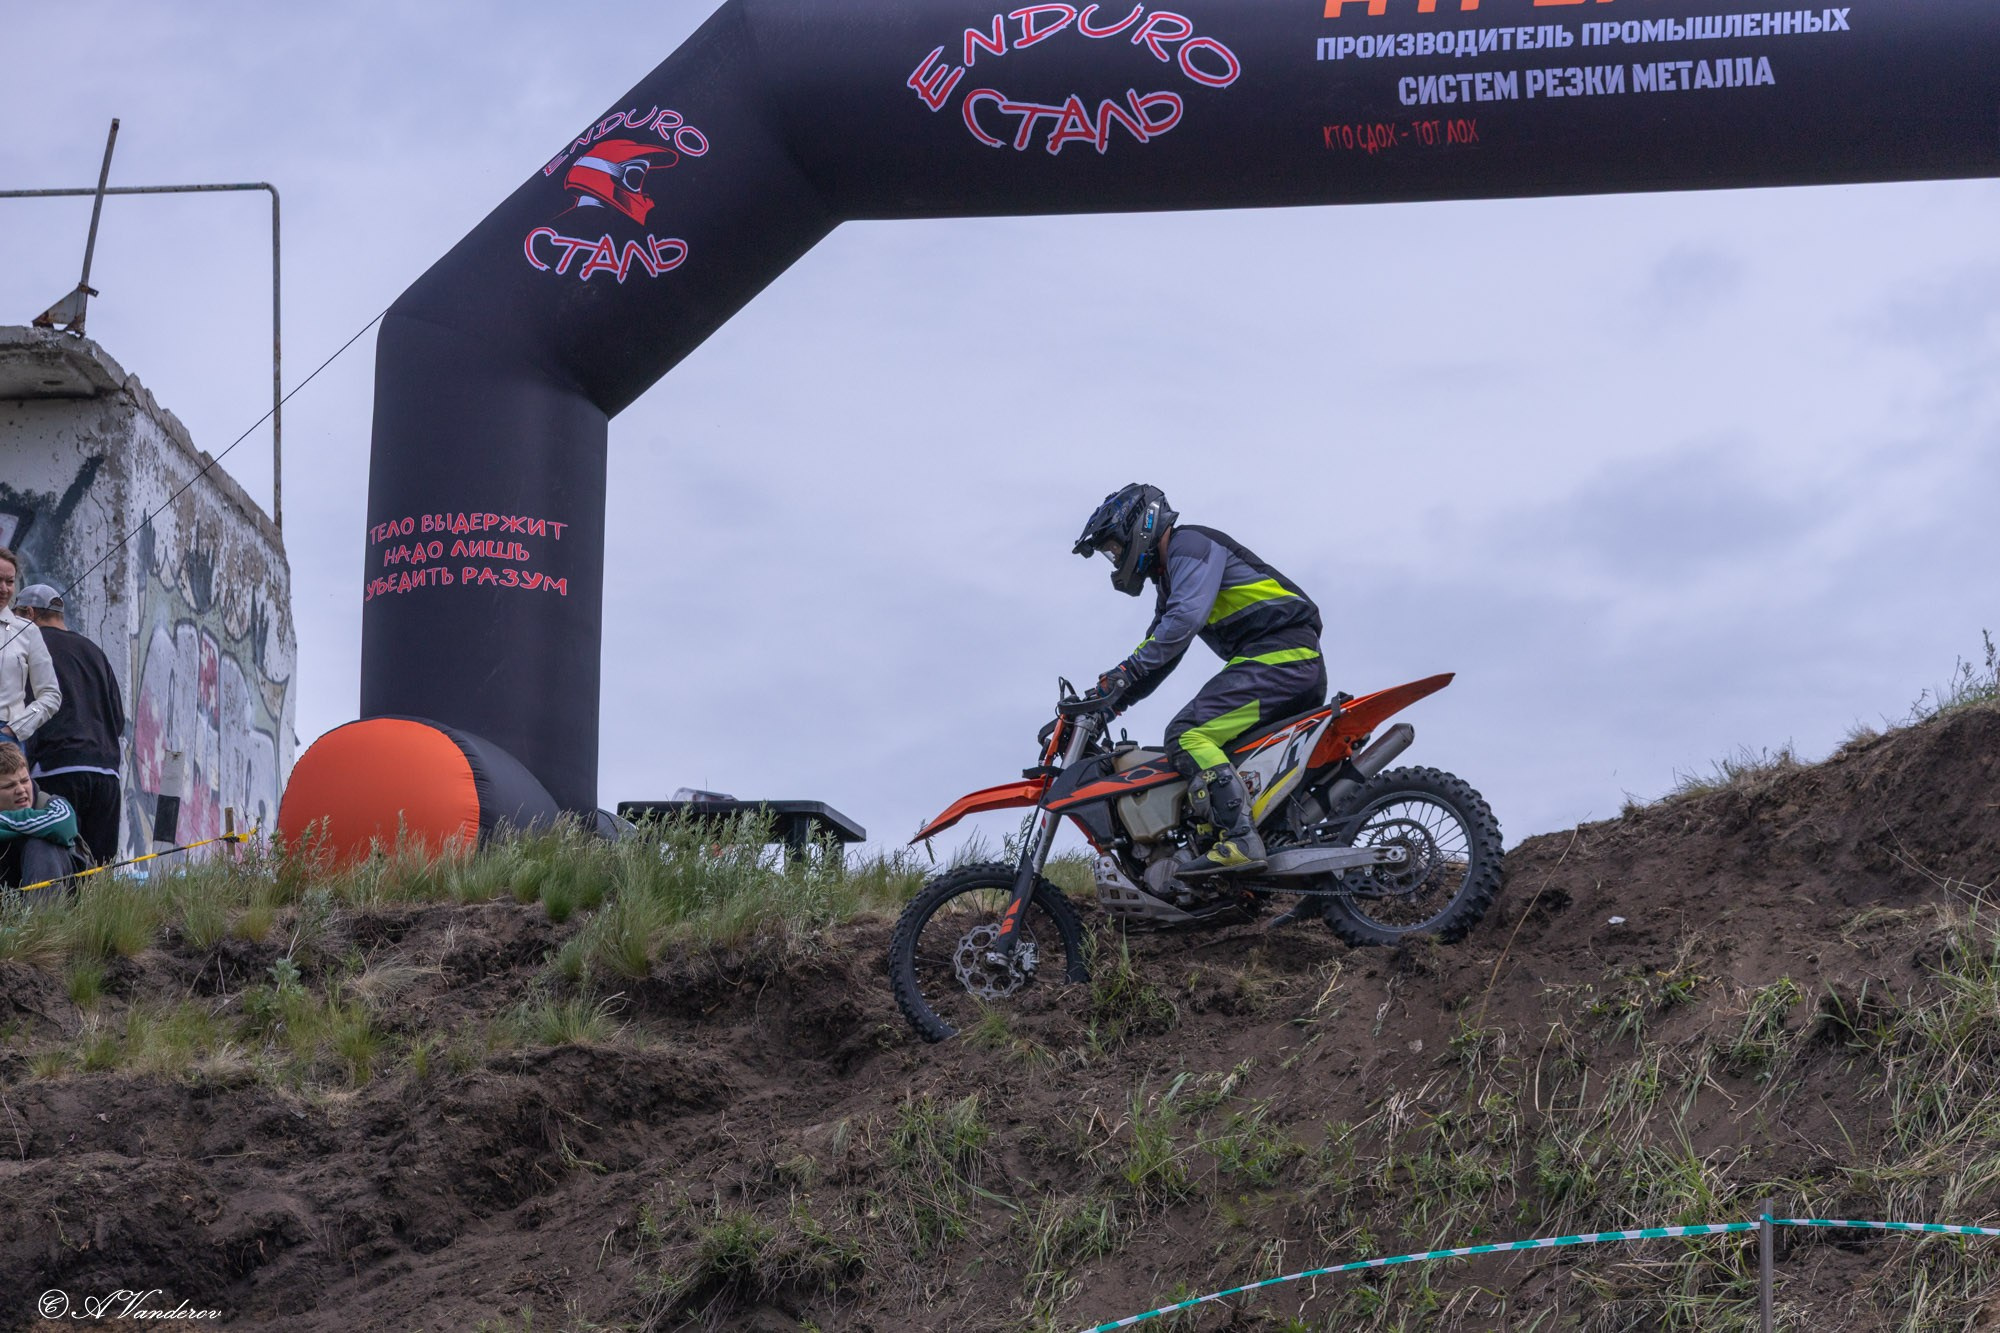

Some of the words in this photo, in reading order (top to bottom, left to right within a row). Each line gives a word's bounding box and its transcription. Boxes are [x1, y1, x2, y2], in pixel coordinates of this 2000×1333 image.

[1316, 24, 1575, 61] ПРОИЗВОДИТЕЛЬ
[1581, 7, 1851, 47] ПРОМЫШЛЕННЫХ
[907, 2, 1241, 112] ENDURO
[1398, 70, 1519, 106] СИСТЕМ
[1525, 64, 1626, 99] РЕЗКИ
[1632, 56, 1776, 94] МЕТАЛЛА
[543, 104, 710, 177] ENDURO
[1323, 124, 1354, 150] КТО
[1356, 122, 1398, 155] СДОХ
[1411, 120, 1441, 146] ТОТ
[1446, 118, 1479, 145] ЛОХ
[369, 516, 415, 546] ТЕЛО
[421, 512, 569, 541] ВЫДЕРЖИТ
[383, 540, 444, 567] НАДО
[450, 539, 530, 561] ЛИШЬ
[365, 566, 454, 602] УБЕДИТЬ
[461, 566, 568, 596] РАЗУМ
